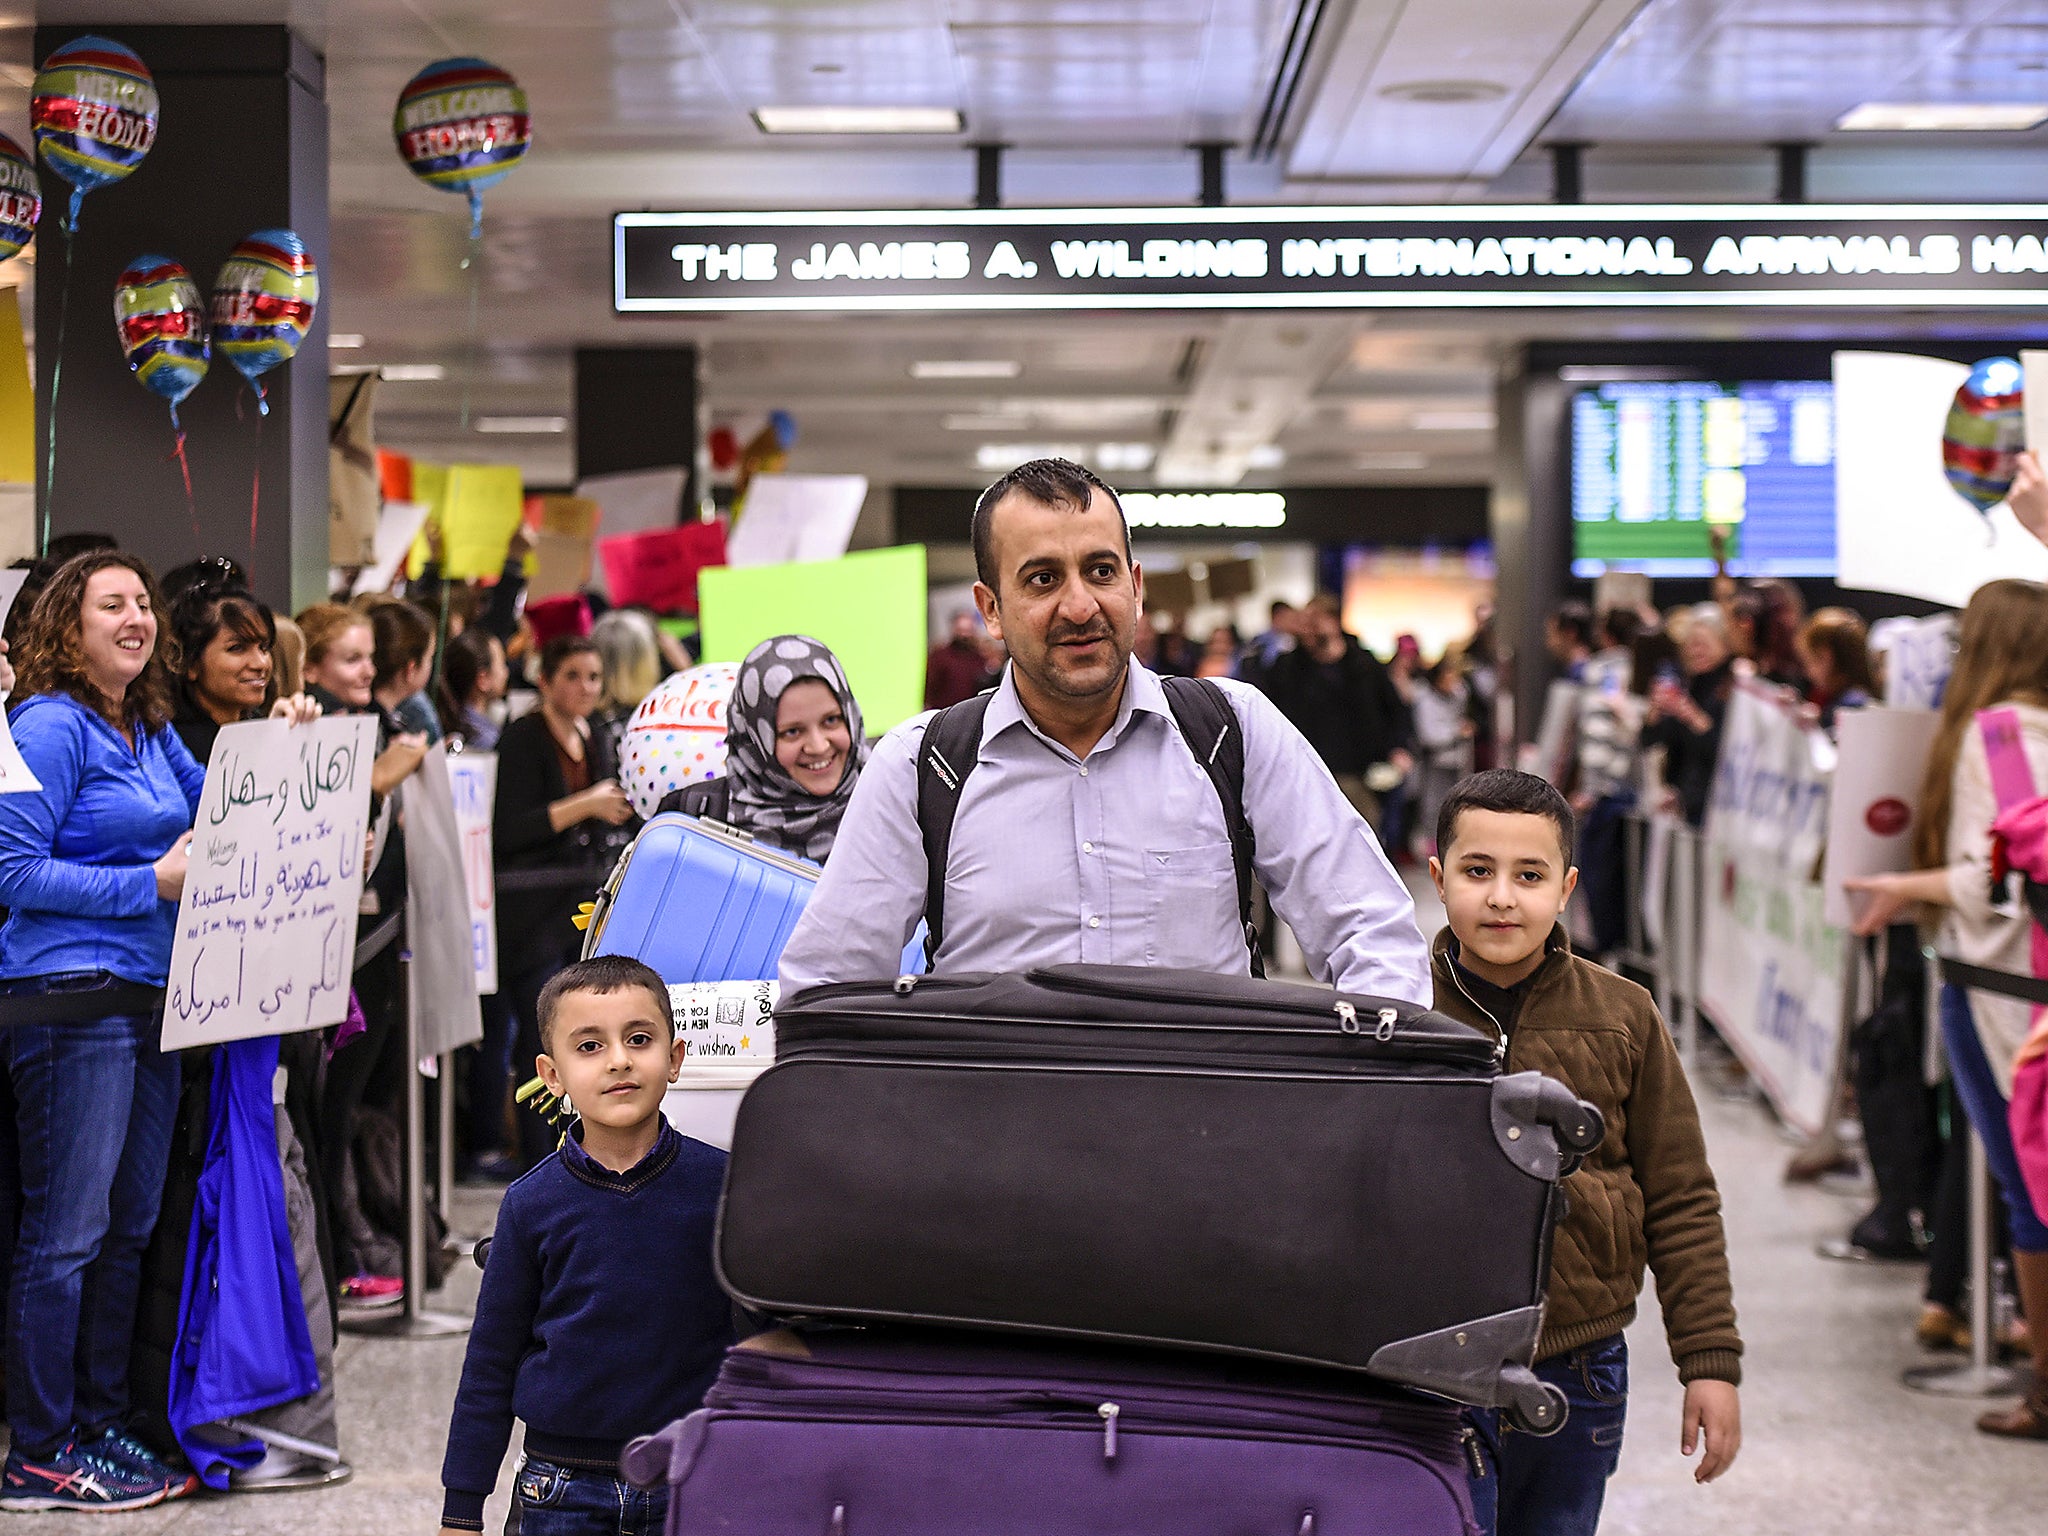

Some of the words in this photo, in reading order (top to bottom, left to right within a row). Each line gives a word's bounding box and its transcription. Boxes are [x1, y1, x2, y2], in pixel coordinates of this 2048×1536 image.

[411, 115, 516, 159] HOME
[672, 243, 778, 281] THE
[791, 241, 971, 280] JAMES
[983, 241, 1039, 279] A.
[1050, 239, 1268, 278] WILDING
[1282, 237, 1693, 276] INTERNATIONAL
[1702, 235, 1960, 275] ARRIVALS
[1972, 235, 2048, 273] HA
[691, 1006, 708, 1017] FOR
[691, 1019, 708, 1030] NEW
